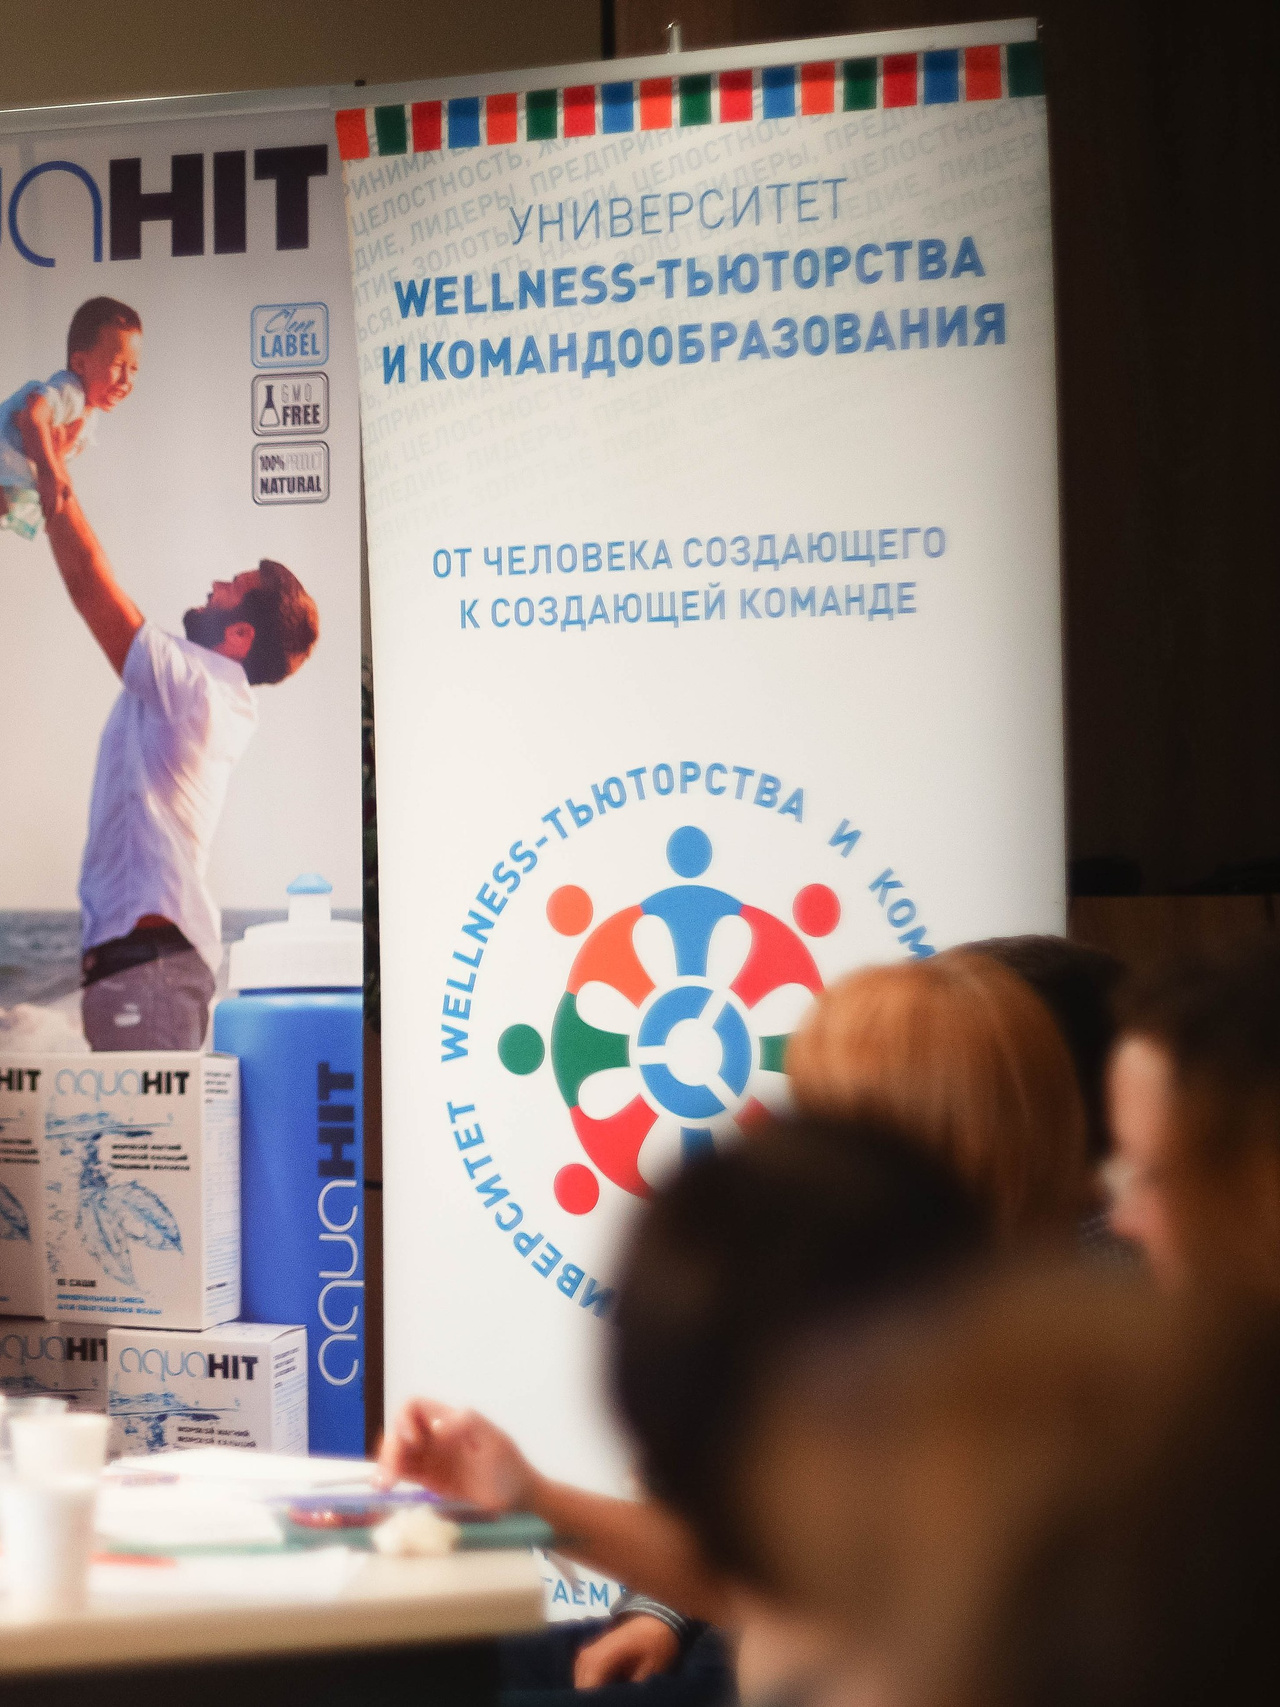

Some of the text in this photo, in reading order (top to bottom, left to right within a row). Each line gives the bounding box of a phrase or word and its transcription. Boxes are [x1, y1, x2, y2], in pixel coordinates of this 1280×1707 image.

[509, 177, 848, 246] УНИВЕРСИТЕТ
[394, 236, 985, 319] WELLNESS-ТЬЮТОРСТВА
[260, 333, 321, 358] LABEL
[382, 345, 406, 385] И
[420, 302, 1007, 382] КОМАНДООБРАЗОВАНИЯ
[282, 404, 321, 426] FREE
[260, 474, 322, 495] NATURAL
[432, 526, 947, 578] ОТ ЧЕЛОВЕКА СОЗДАЮЩЕГО
[459, 581, 918, 632] К СОЗДАЮЩЕЙ КОМАНДЕ
[440, 760, 938, 1064] WELLNESS-ТЬЮТОРСТВА И КОМ
[55, 1068, 191, 1102] aquaHIT
[317, 1061, 366, 1386] aquaHIT
[446, 1099, 620, 1320] ИВЕРСИТЕТ
[120, 1347, 259, 1382] aquaHIT
